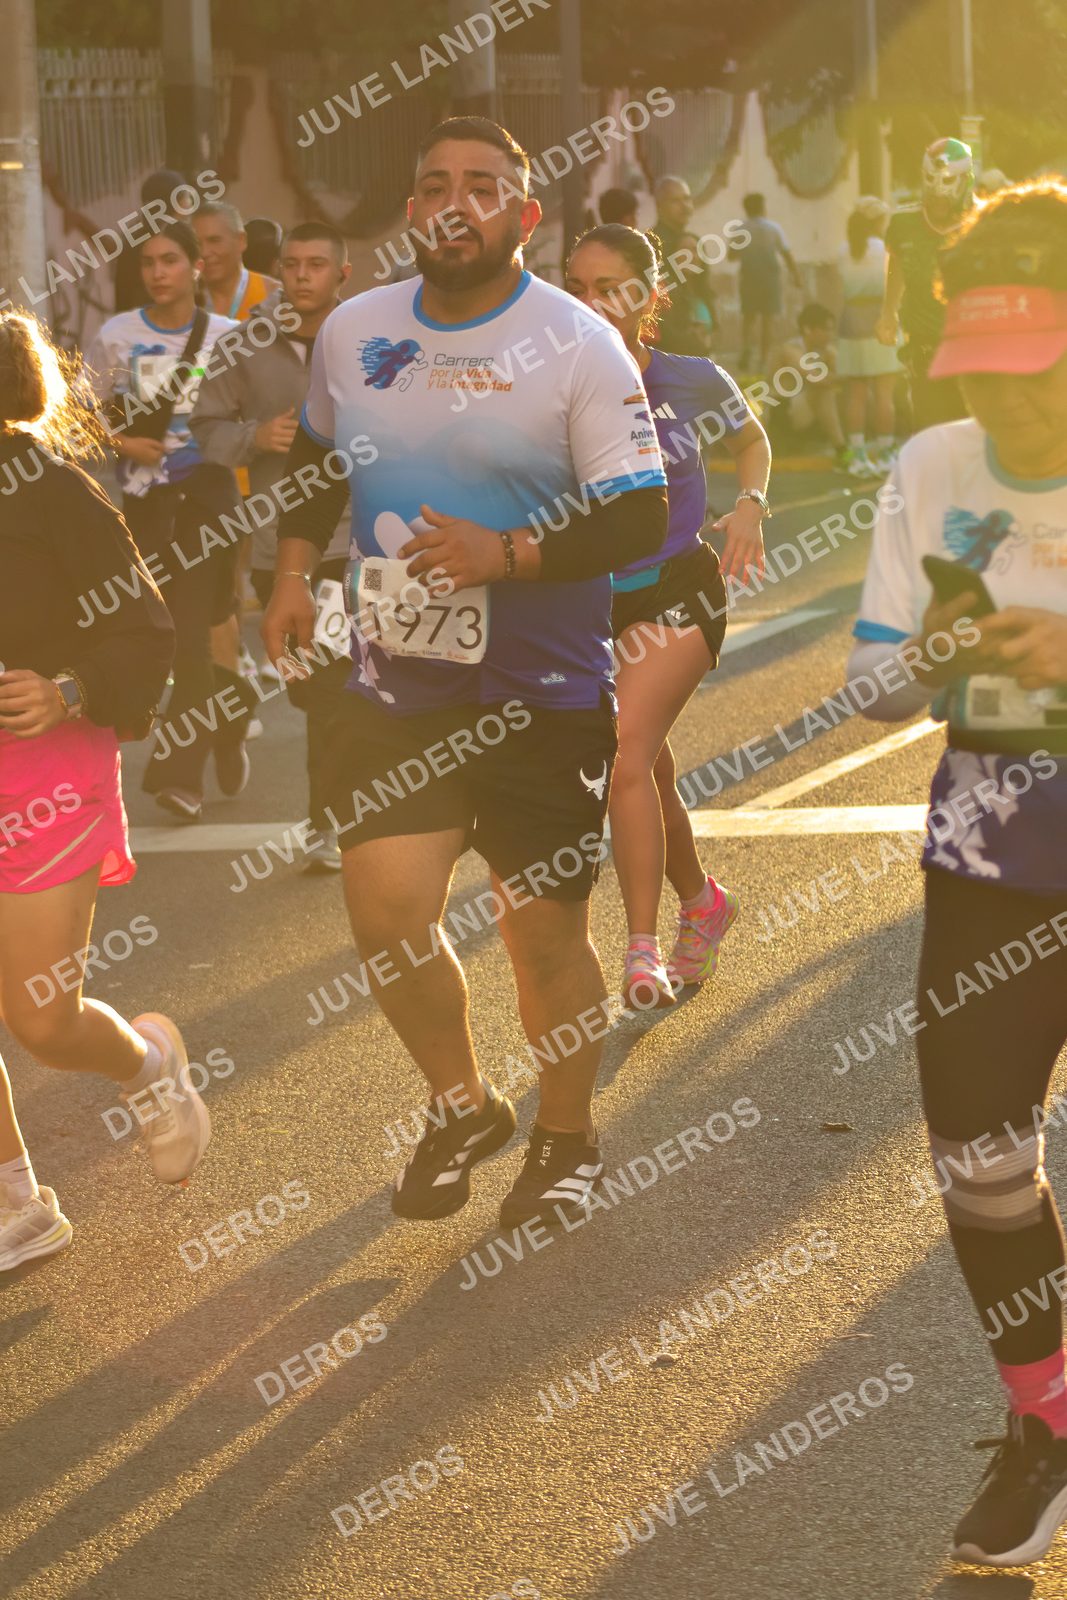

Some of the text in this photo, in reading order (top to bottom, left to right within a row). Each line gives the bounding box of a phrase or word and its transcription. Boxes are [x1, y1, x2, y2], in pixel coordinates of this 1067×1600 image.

[433, 353, 495, 368] Carrera
[430, 367, 493, 379] por la Vida
[426, 380, 434, 390] y
[436, 379, 447, 390] la
[366, 601, 483, 650] 1973
